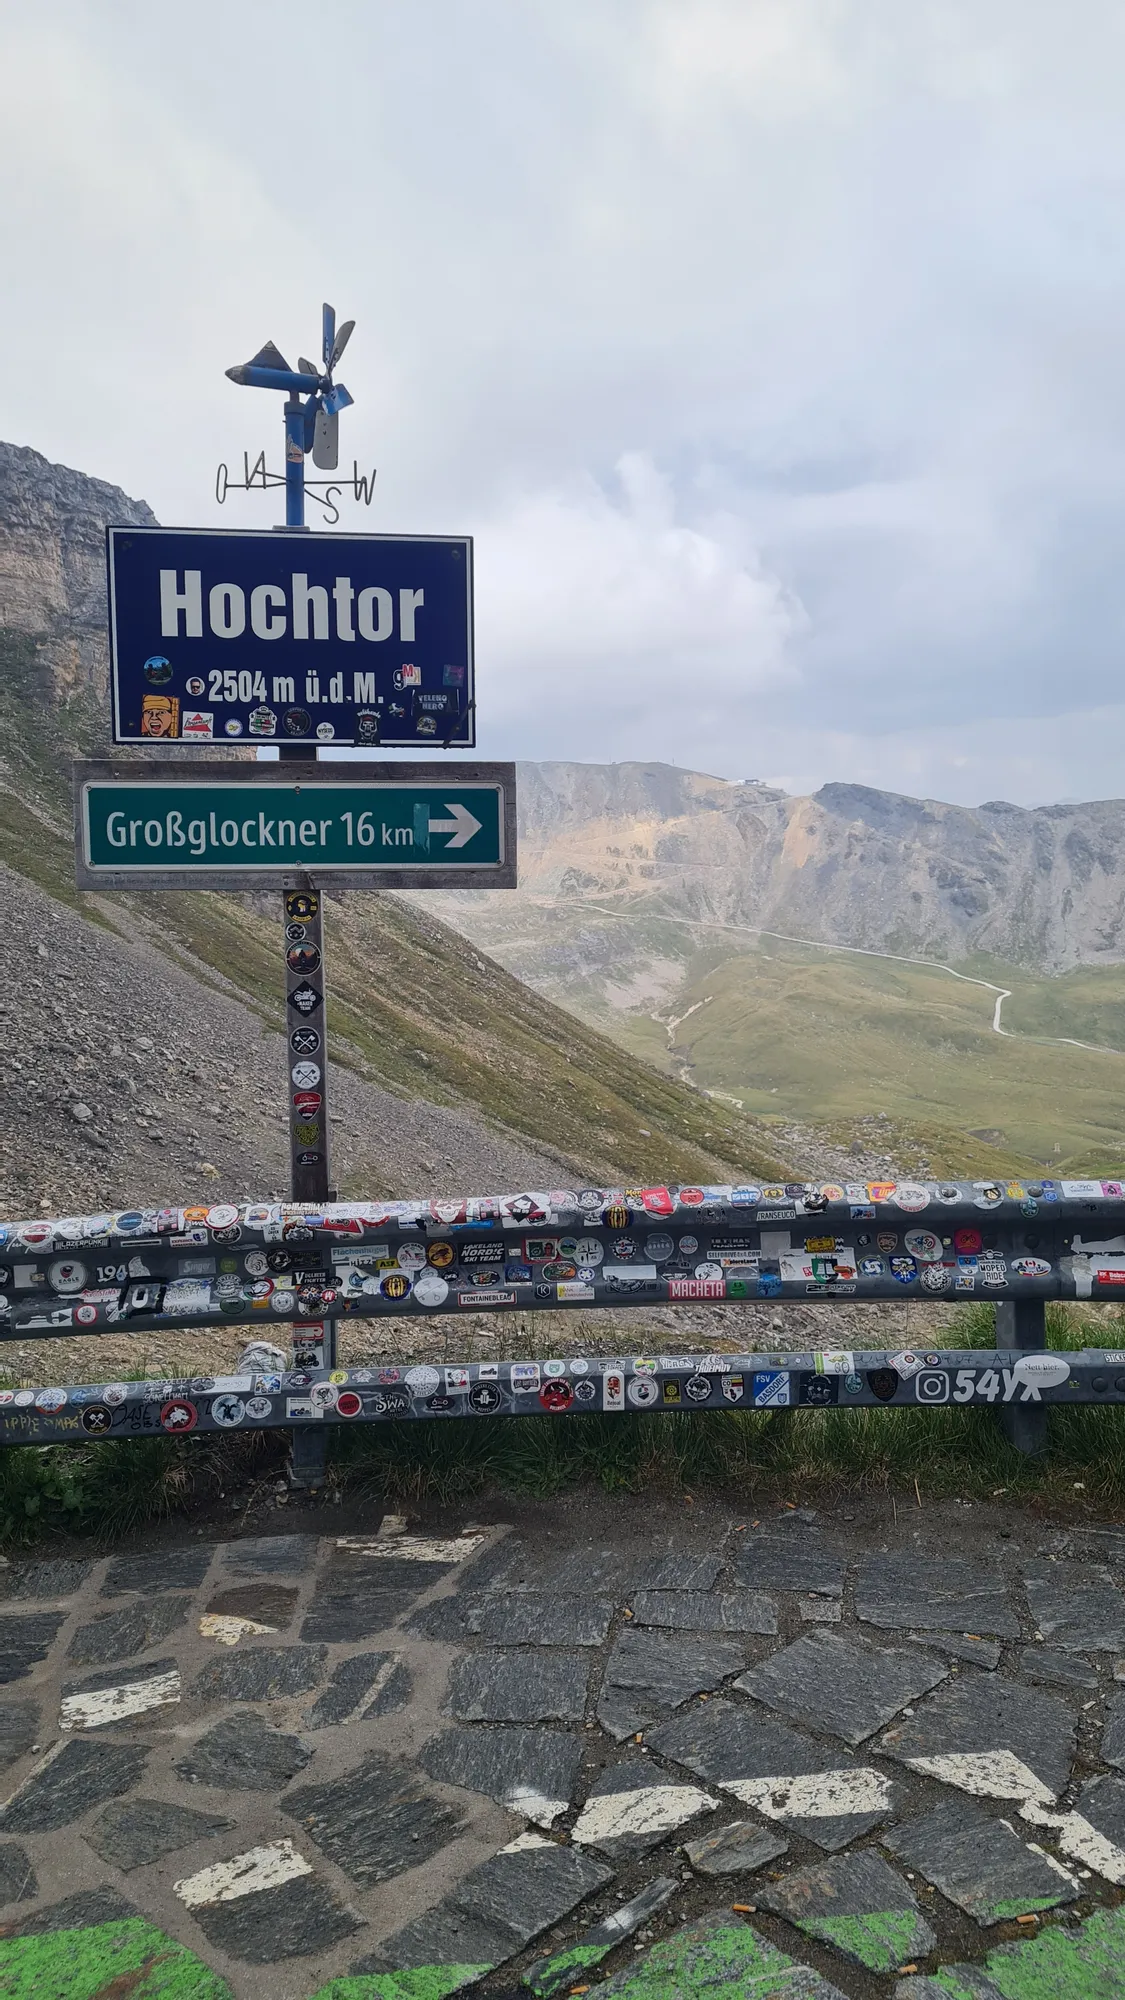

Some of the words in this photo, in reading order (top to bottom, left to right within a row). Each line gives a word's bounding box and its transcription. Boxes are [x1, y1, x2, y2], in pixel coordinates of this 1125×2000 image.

[159, 569, 424, 642] Hochtor
[208, 669, 267, 703] 2504
[273, 676, 295, 703] m
[106, 810, 333, 855] Großglockner
[340, 811, 375, 847] 16
[381, 823, 413, 845] km
[61, 1239, 103, 1247] LAZERPUNK
[463, 1242, 503, 1250] LAKELAND
[924, 1239, 932, 1248] 50
[183, 1259, 212, 1274] Singer
[379, 1259, 396, 1268] ASF
[980, 1264, 1006, 1273] MOPED
[58, 1276, 80, 1284] EAGLE
[986, 1272, 1004, 1281] RIDE
[671, 1281, 725, 1298] MACHETA
[462, 1293, 512, 1303] FONTAINEBLEAU
[1025, 1363, 1041, 1371] Nett
[1043, 1362, 1060, 1371] hier.
[756, 1374, 771, 1383] FSV
[758, 1373, 786, 1404] BASDORF
[375, 1396, 408, 1413] SWA
